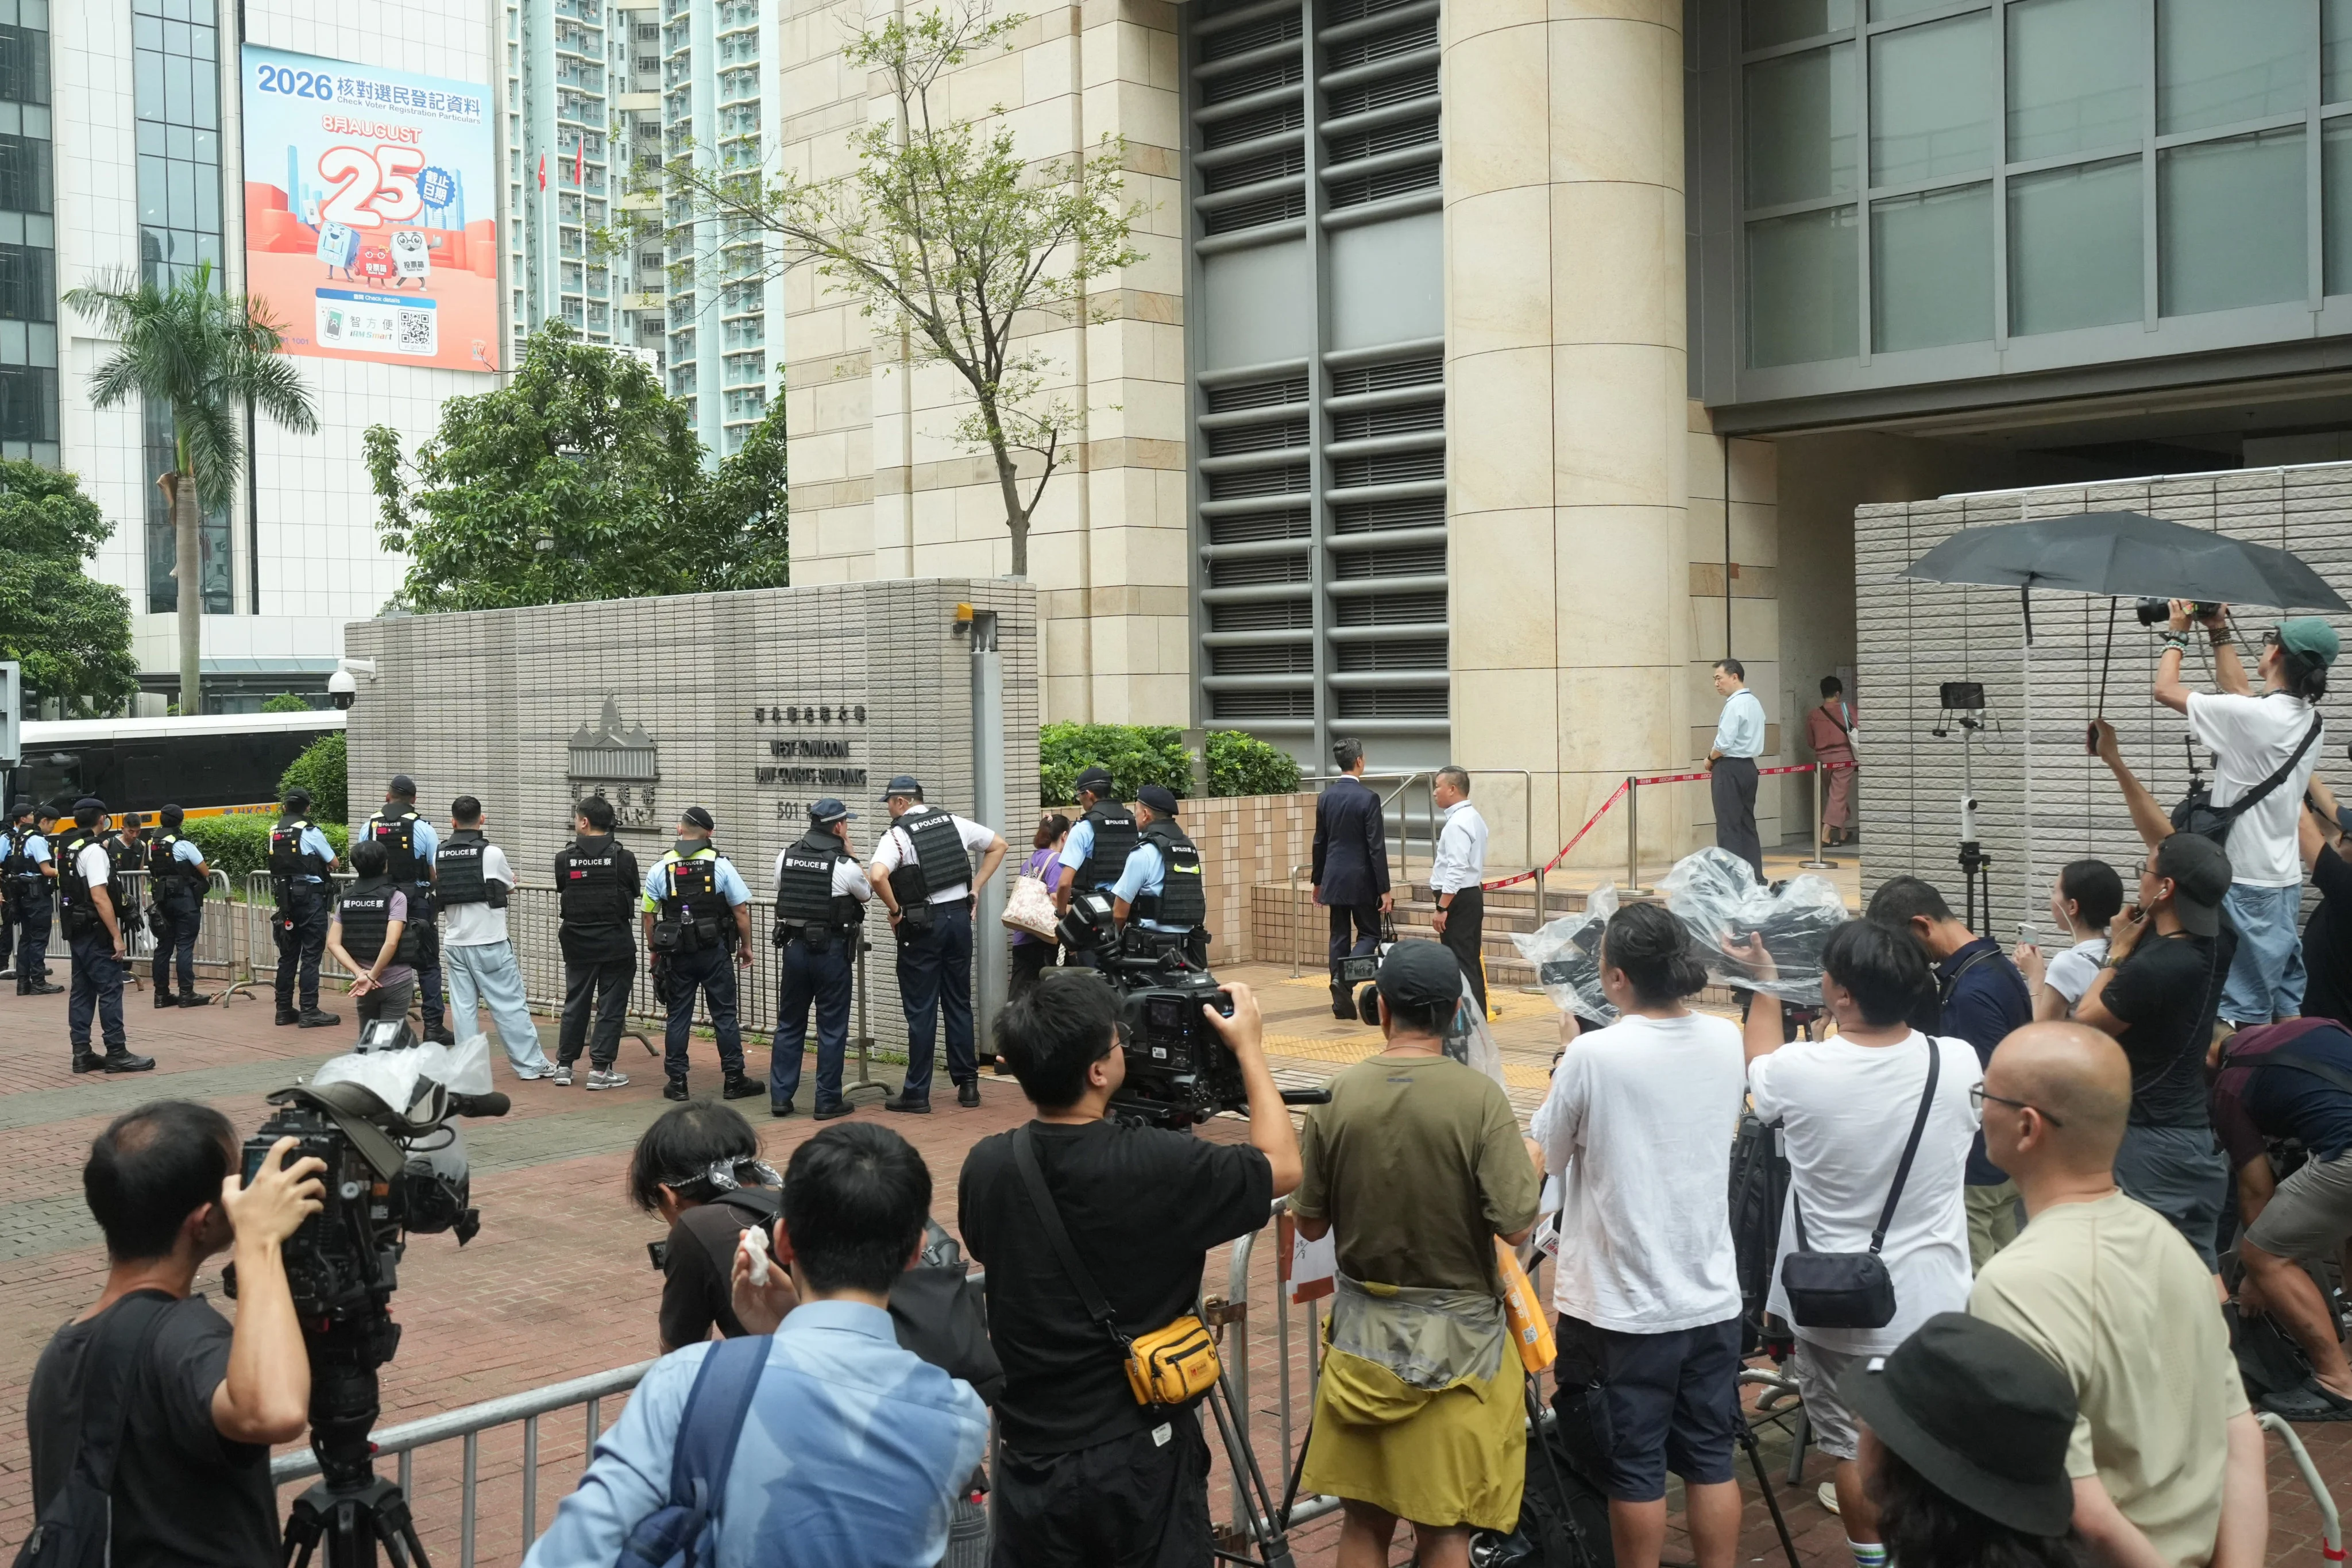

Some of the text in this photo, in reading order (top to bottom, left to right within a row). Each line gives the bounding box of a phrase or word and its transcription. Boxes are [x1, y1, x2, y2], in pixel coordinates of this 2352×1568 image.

[258, 65, 480, 117] 2026 核對選民登記資料
[337, 96, 481, 125] Check Voter Registration Particulars
[318, 144, 425, 229] 25
[366, 331, 392, 340] Smart
[770, 740, 849, 756] WEST KOWLOON
[755, 767, 867, 784] LAW COURTS BUILDING
[777, 801, 798, 820] 501
[918, 817, 943, 828] POLICE
[794, 860, 820, 868] POLICE
